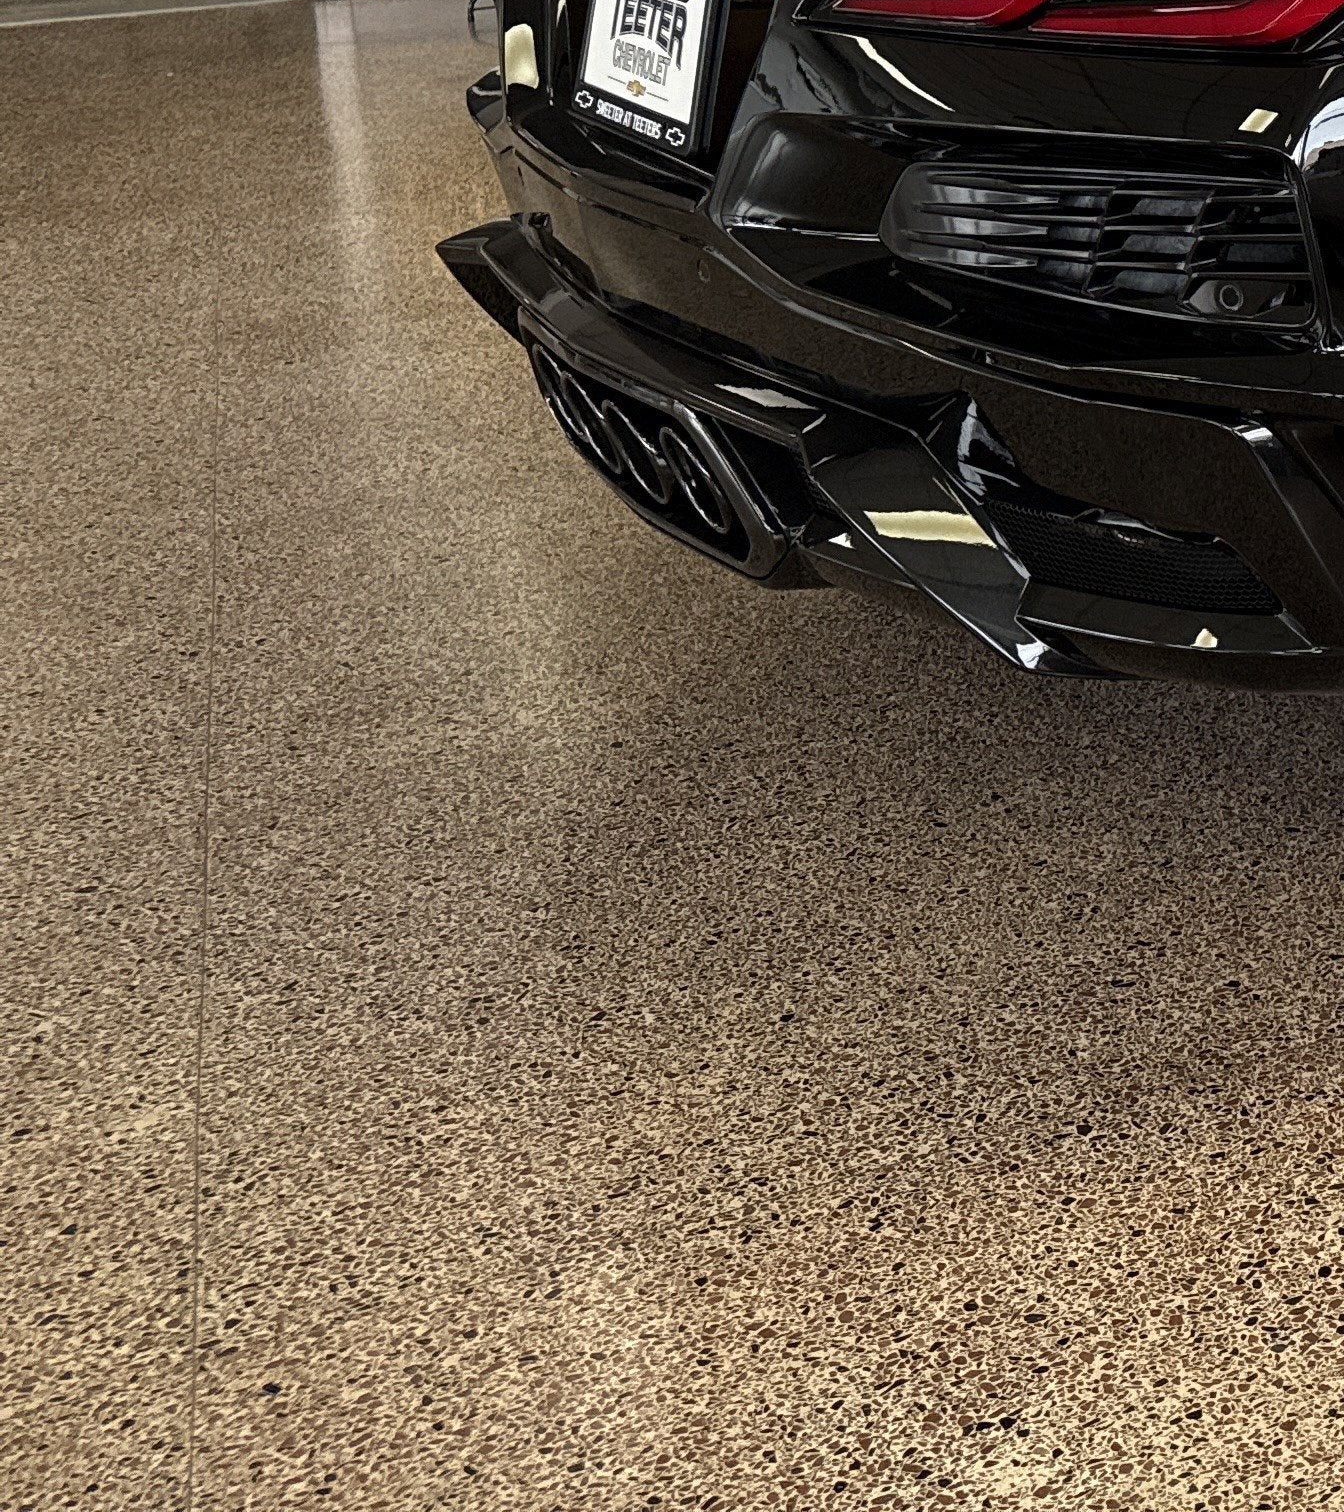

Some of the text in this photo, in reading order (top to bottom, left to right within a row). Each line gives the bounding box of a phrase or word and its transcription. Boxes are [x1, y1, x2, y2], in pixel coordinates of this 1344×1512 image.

[612, 38, 672, 86] CHEVROLET
[595, 98, 624, 125] SWEETER
[622, 108, 633, 128] AT
